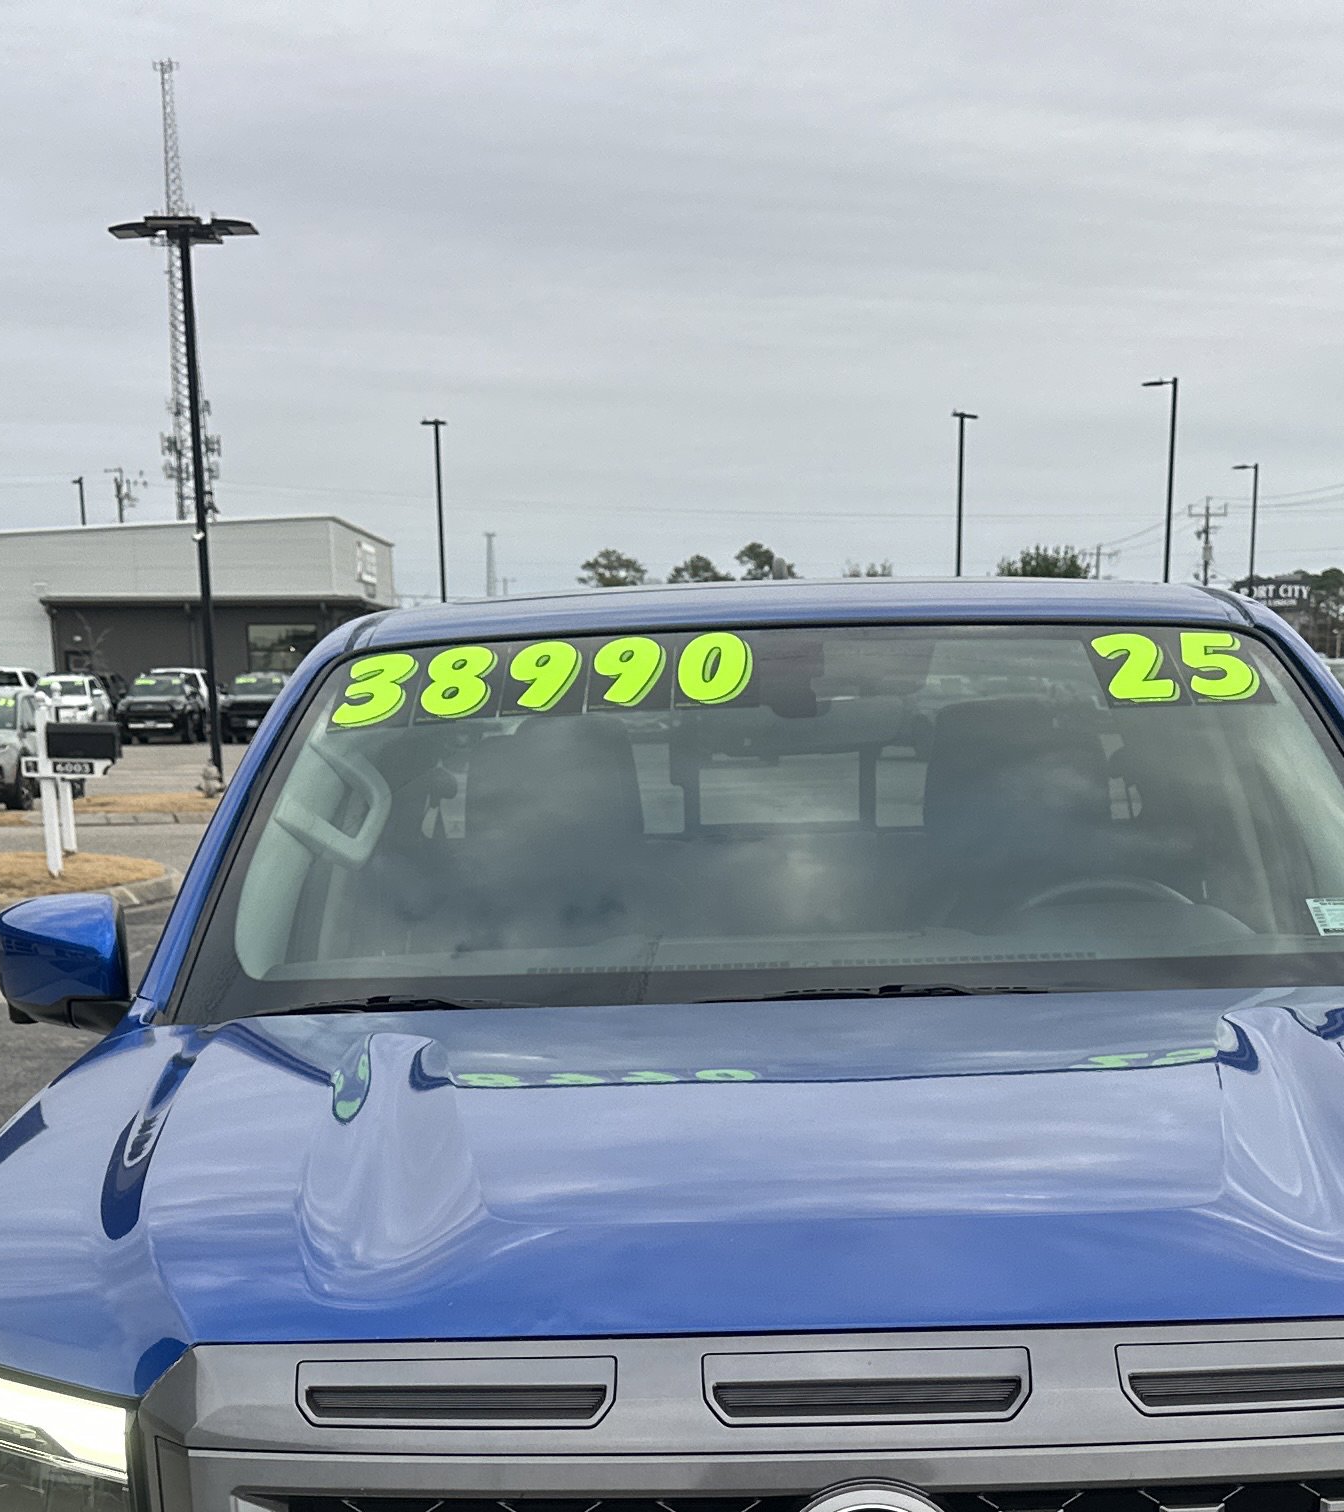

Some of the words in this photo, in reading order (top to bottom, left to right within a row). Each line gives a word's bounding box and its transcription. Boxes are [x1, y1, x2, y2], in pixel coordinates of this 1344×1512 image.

[1278, 583, 1311, 599] CITY
[331, 632, 753, 728] 38990
[1091, 632, 1260, 702] 25
